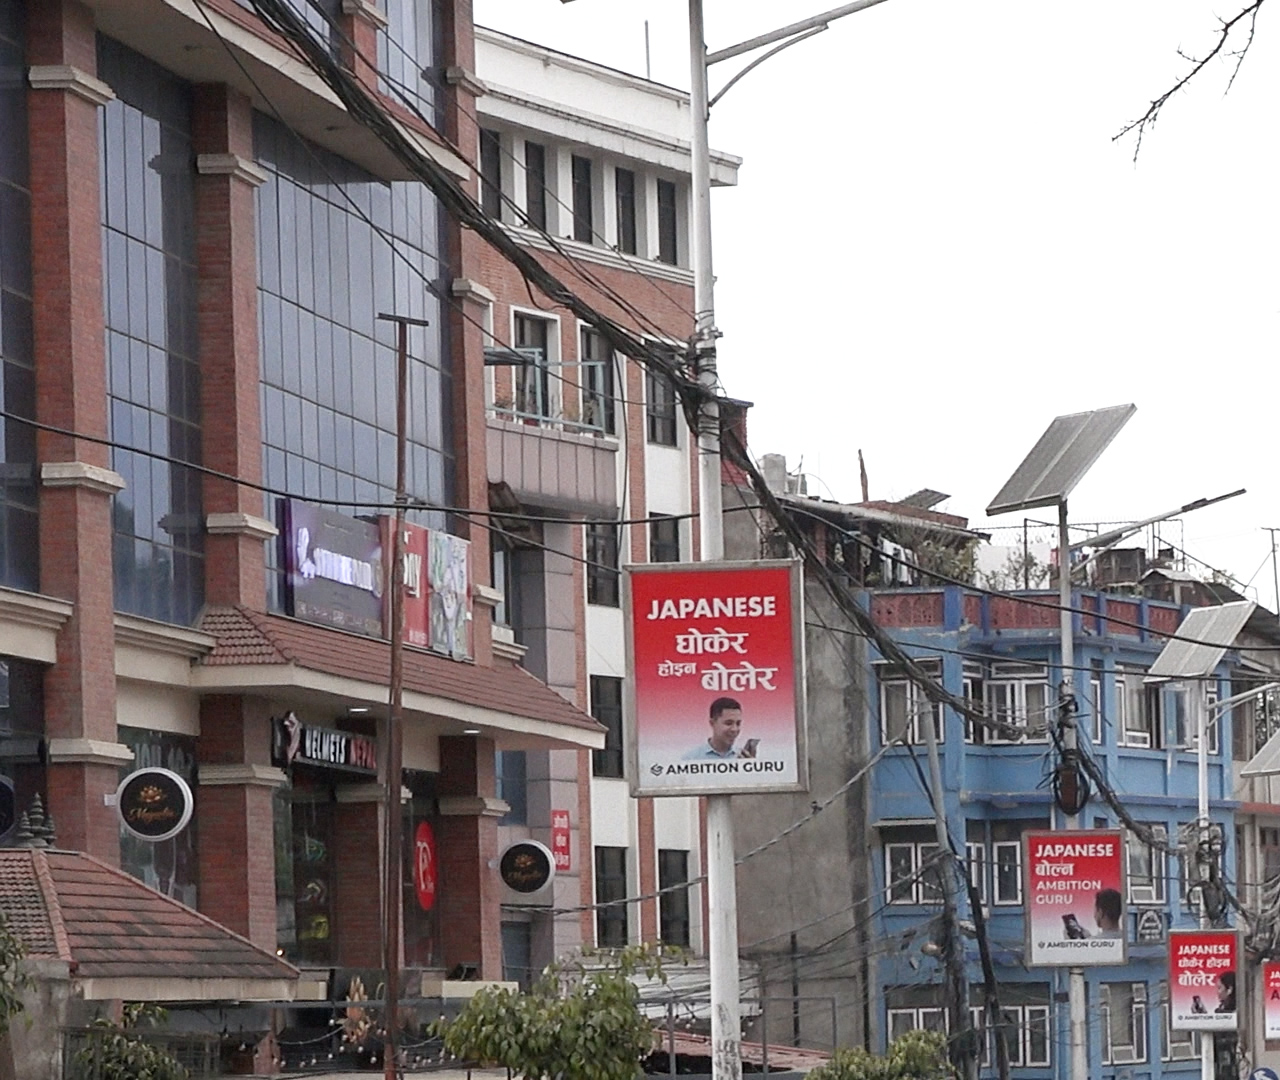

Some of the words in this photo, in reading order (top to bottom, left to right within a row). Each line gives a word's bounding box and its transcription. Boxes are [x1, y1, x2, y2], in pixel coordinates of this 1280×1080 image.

[646, 596, 776, 620] JAPANESE
[675, 627, 749, 654] घोकेर
[657, 660, 697, 677] होइन
[701, 661, 778, 691] बोलेर
[305, 729, 346, 764] HELMETS
[665, 762, 739, 775] AMBITION
[743, 761, 785, 773] GURU
[1035, 844, 1114, 858] JAPANESE
[1036, 880, 1102, 891] AMBITION
[1036, 894, 1073, 905] GURU
[1047, 940, 1088, 949] AMBITION
[1090, 940, 1115, 949] GURU
[1178, 945, 1230, 955] JAPANESE
[1178, 970, 1217, 987] बोलेर
